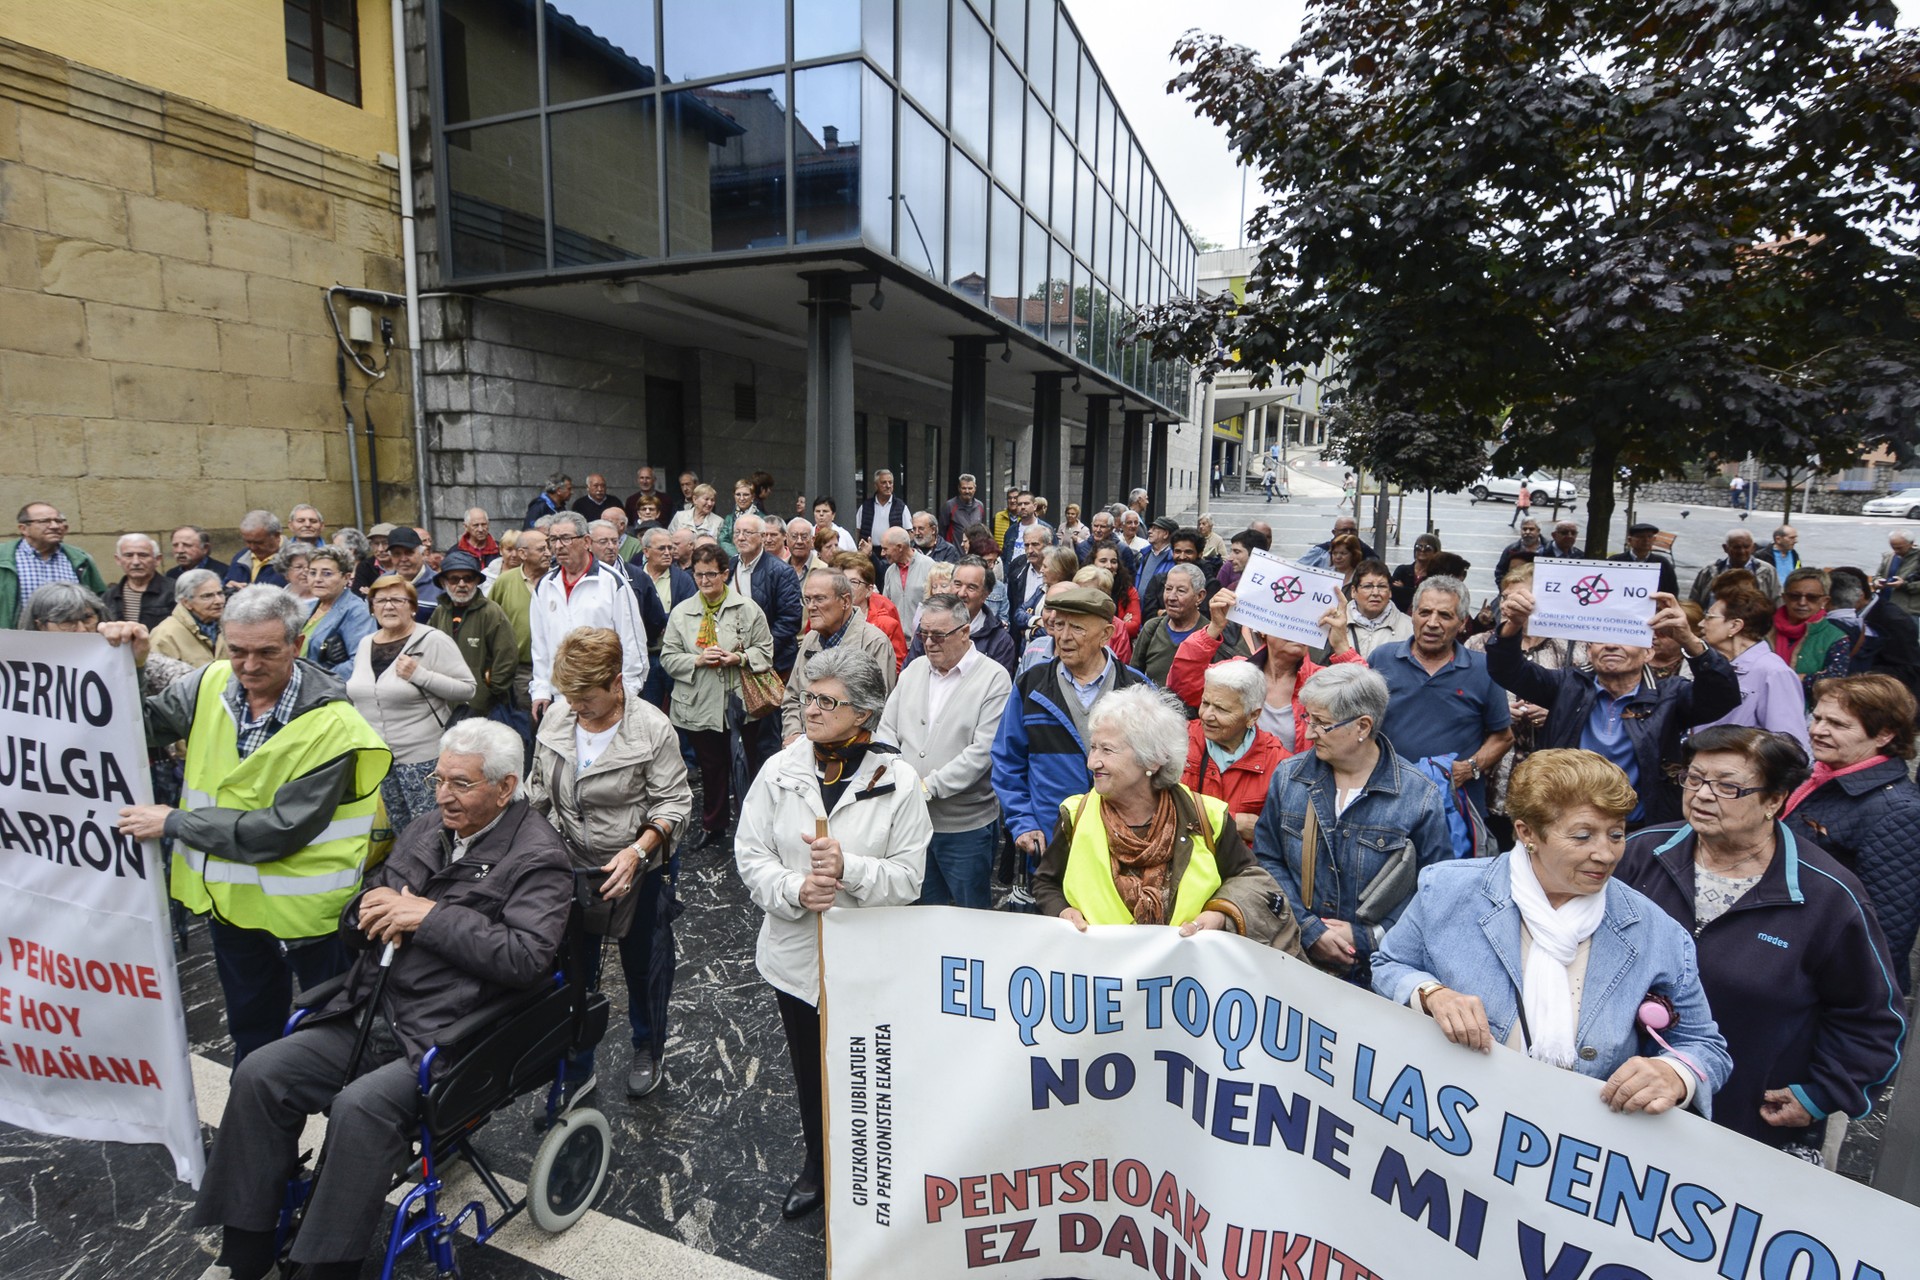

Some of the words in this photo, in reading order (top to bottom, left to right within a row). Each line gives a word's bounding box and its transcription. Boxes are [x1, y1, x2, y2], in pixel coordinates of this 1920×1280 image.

[1251, 572, 1265, 585] EZ
[1312, 592, 1332, 604] NO
[1545, 582, 1561, 593] EZ
[1623, 587, 1648, 598] NO
[1233, 606, 1245, 614] LAS
[1245, 610, 1278, 626] PENSIONES
[1287, 624, 1323, 637] DEFIENDEN
[1290, 616, 1319, 628] GOBIERN
[1549, 621, 1590, 630] PENSIONES
[1602, 626, 1646, 635] DEFIENDEN
[1577, 615, 1602, 623] QUIEN
[1603, 617, 1643, 626] GOBIERNE
[8, 937, 163, 1000] PENSIONE
[19, 995, 82, 1037] HOY
[12, 1043, 162, 1091] MAÑANA
[850, 1036, 868, 1115] JUBILATUEN
[875, 1023, 891, 1090] ELKARTEA
[941, 956, 995, 1021] EL
[1008, 966, 1123, 1047] QUE
[1137, 975, 1337, 1087] TOQUE
[1353, 1043, 1478, 1156] LAS
[1494, 1111, 1886, 1280] PENSIO
[852, 1118, 868, 1206] GIPUZKOAKO
[876, 1093, 891, 1199] PENTSIONISTEN
[1031, 1052, 1136, 1110] NO
[1154, 1050, 1354, 1179] TIENE
[1370, 1145, 1488, 1260] MI
[876, 1202, 890, 1227] ETA
[924, 1158, 1211, 1268] PENTSIOAK
[1222, 1223, 1385, 1280] UKIT
[966, 1219, 1040, 1268] EZ
[1059, 1213, 1201, 1280] DAU
